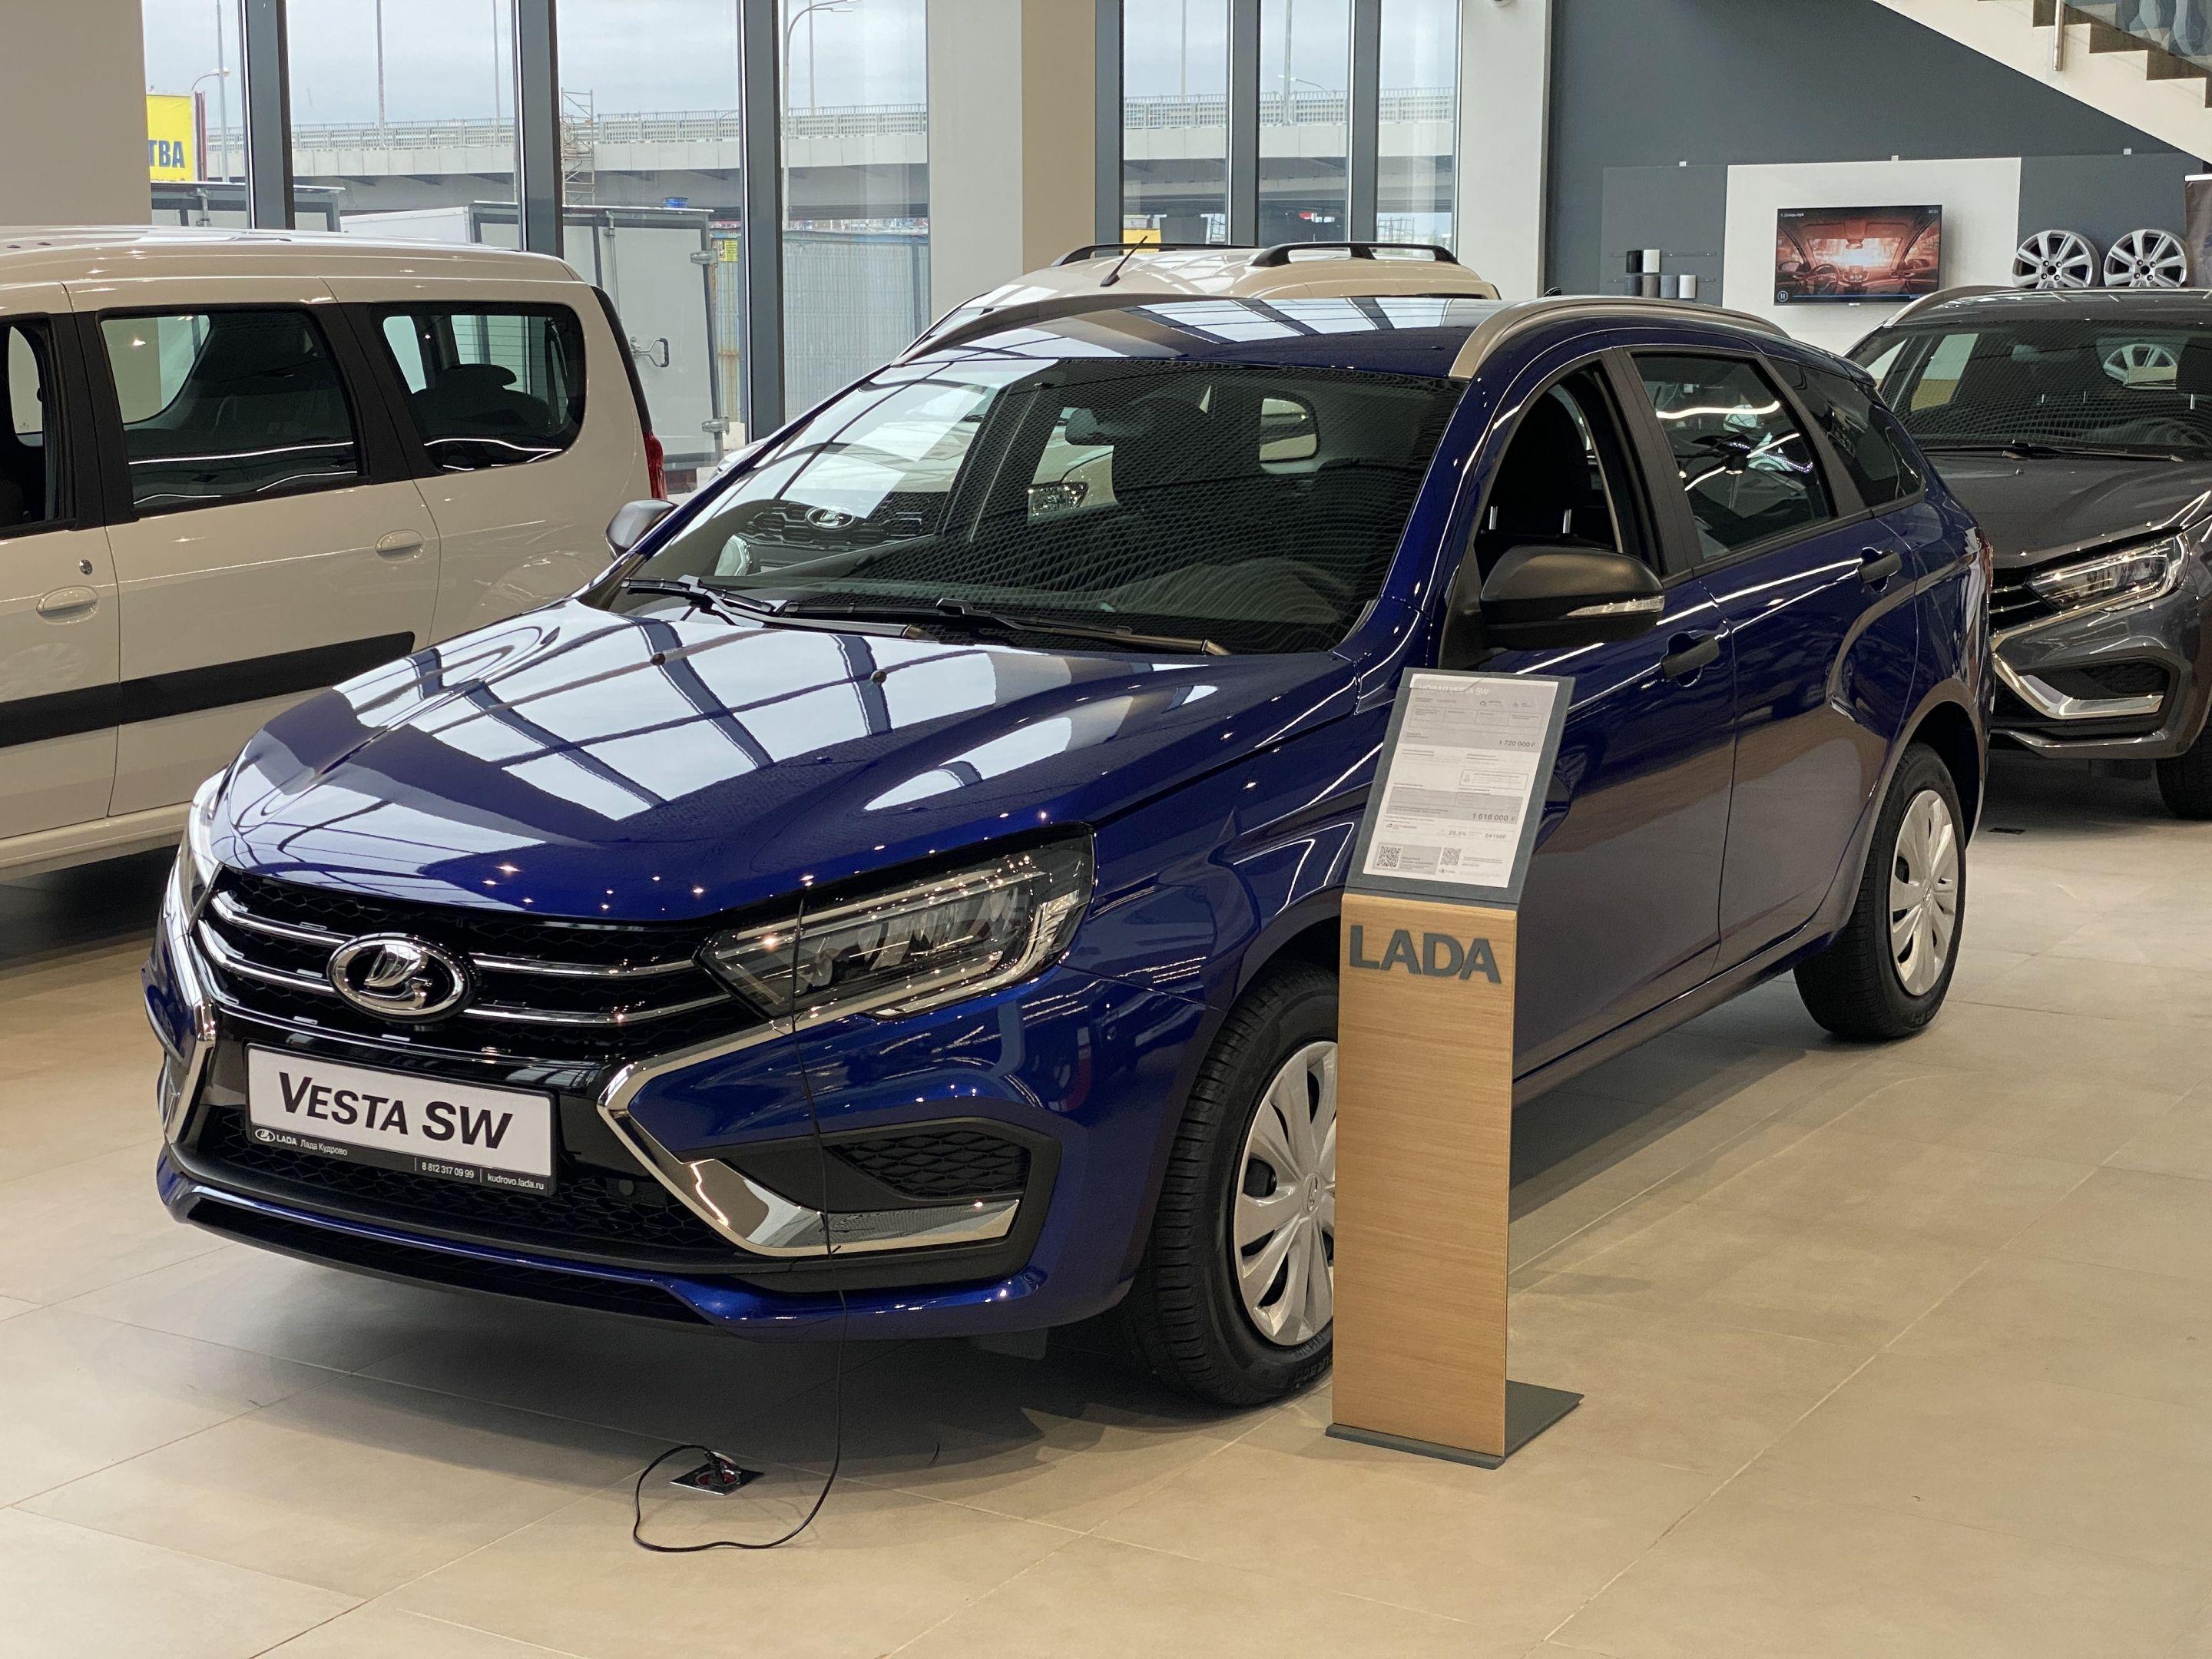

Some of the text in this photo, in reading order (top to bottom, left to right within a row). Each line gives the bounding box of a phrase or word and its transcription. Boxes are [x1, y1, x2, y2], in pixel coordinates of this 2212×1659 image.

[1349, 925, 1502, 984] LADA
[279, 1071, 514, 1150] VESTA SW
[276, 1134, 297, 1145] LADA
[300, 1140, 348, 1155] Лада Кудрово
[422, 1162, 474, 1178] 8 812 317 09 99
[487, 1174, 545, 1190] kudrovo.lada.ru
